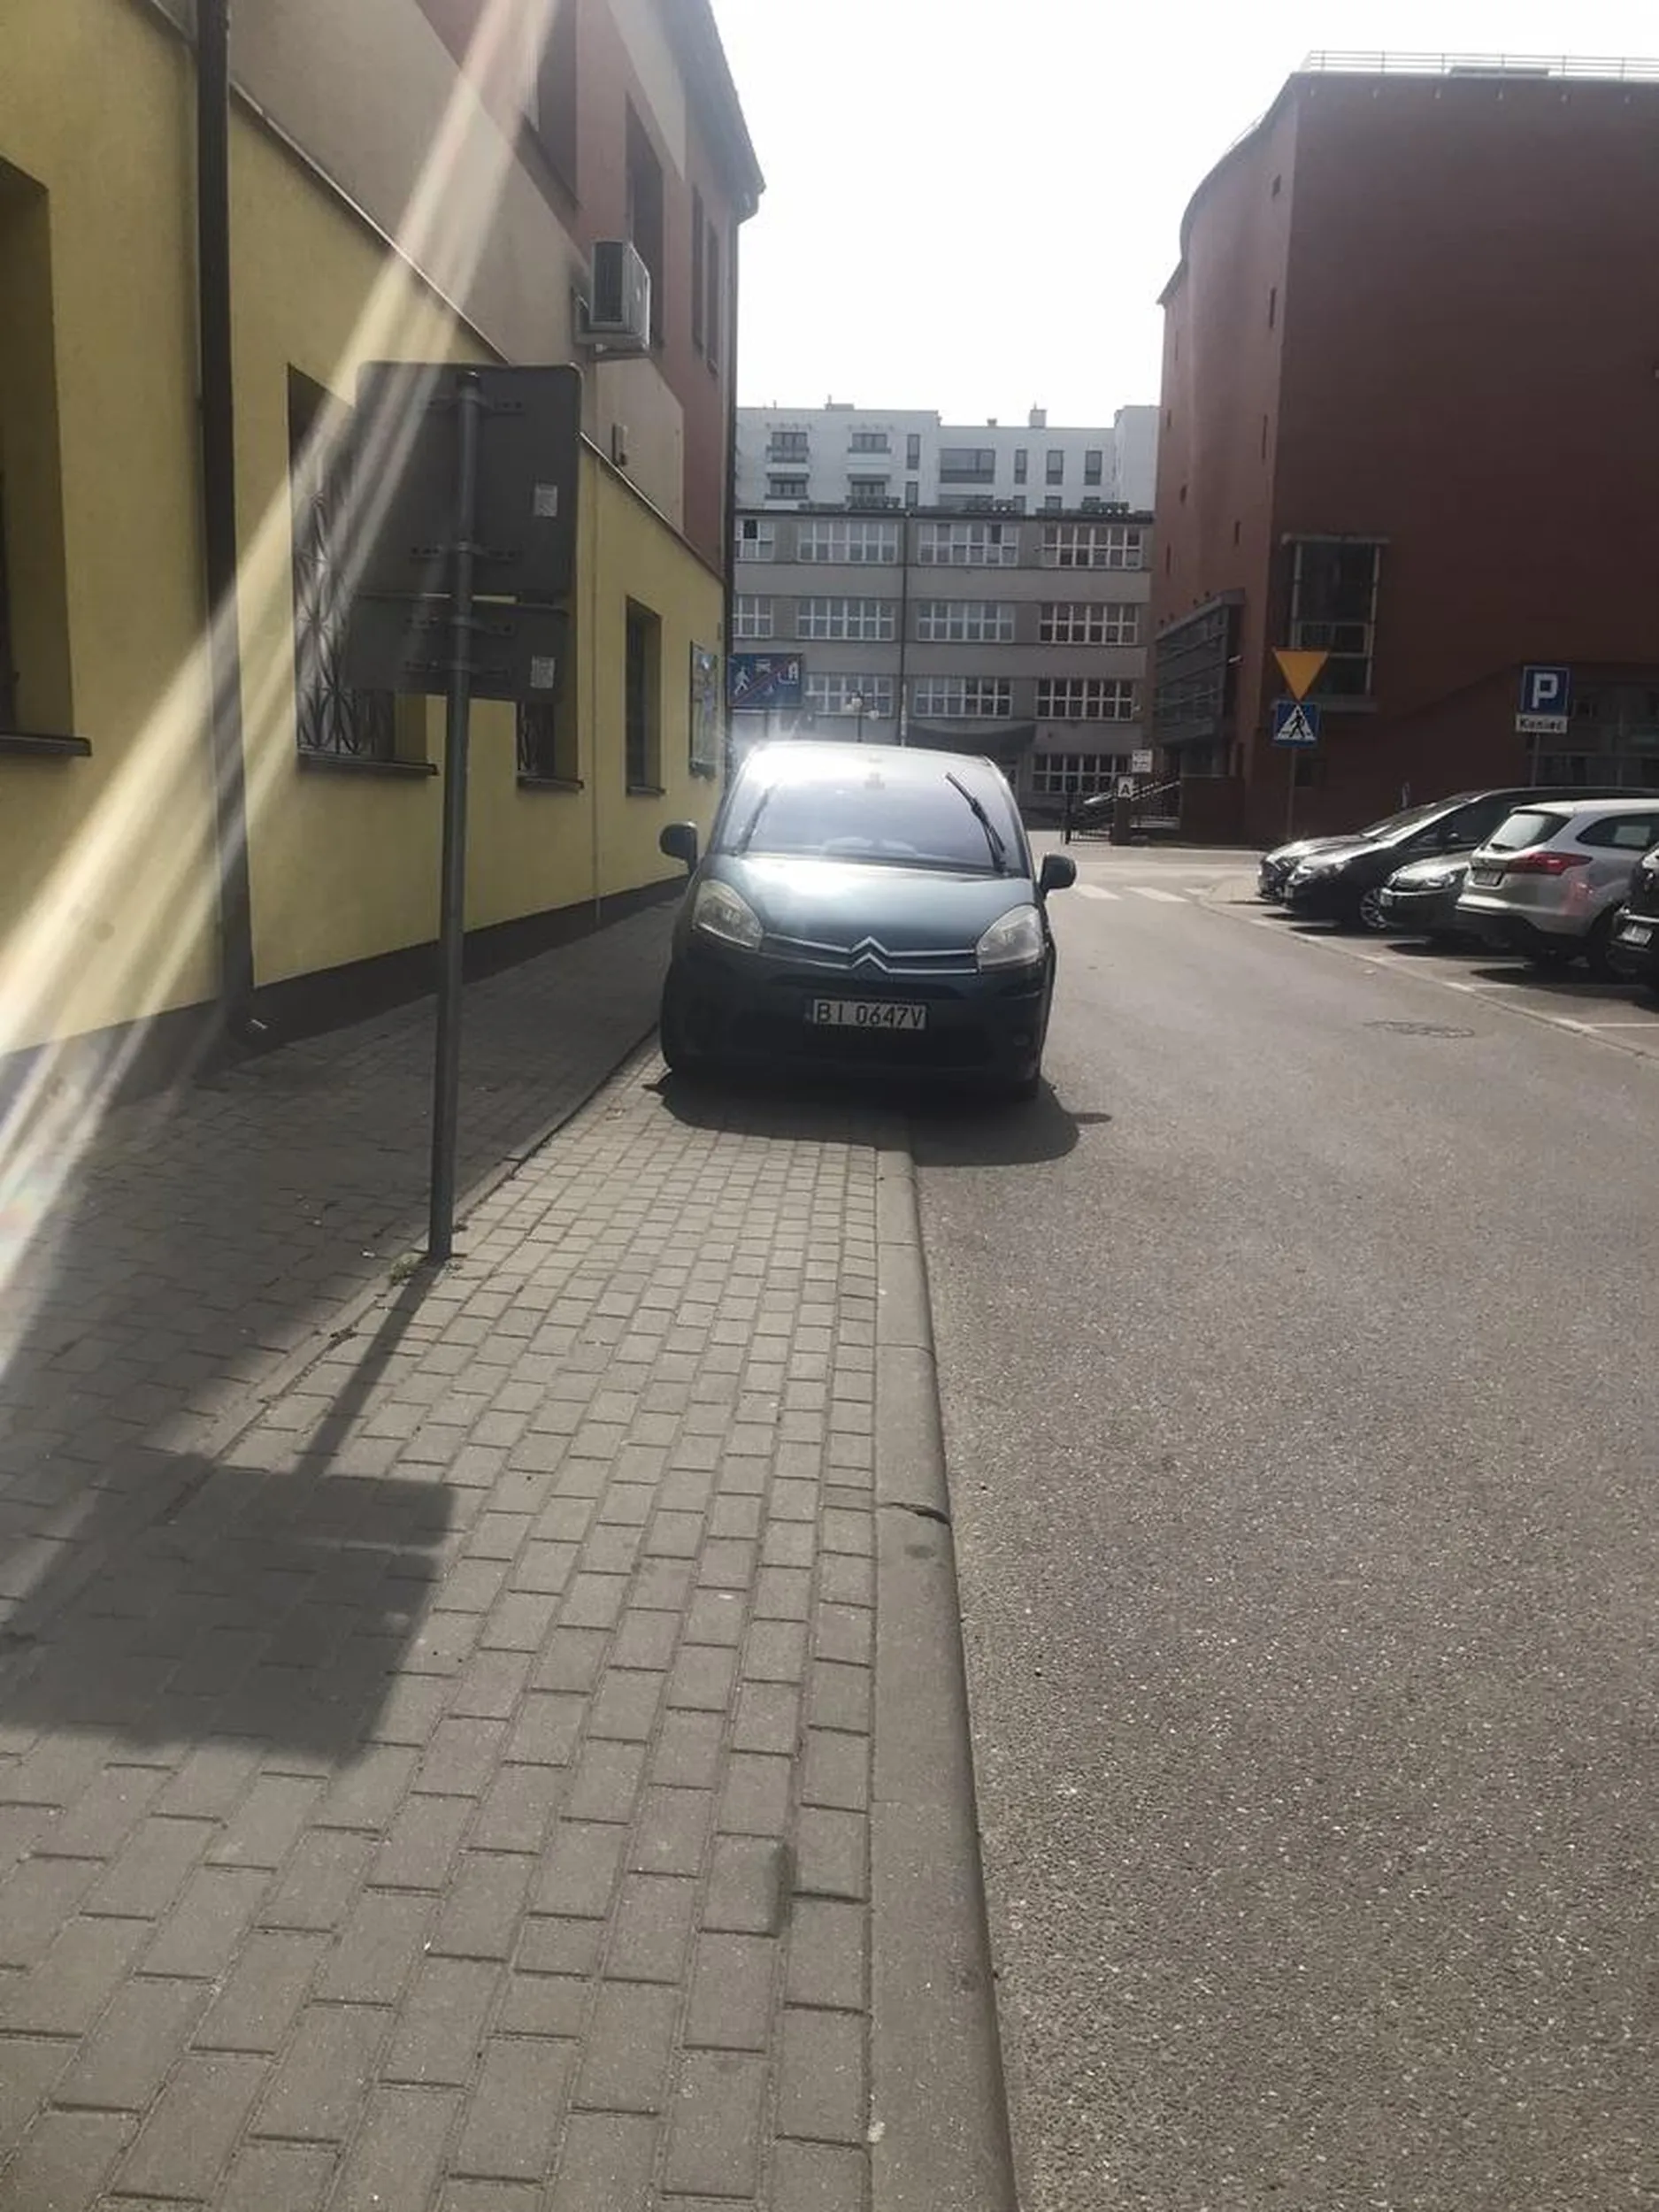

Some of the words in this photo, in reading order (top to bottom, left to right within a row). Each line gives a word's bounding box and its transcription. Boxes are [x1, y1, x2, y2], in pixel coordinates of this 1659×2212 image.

[1532, 672, 1558, 709] P
[817, 1002, 843, 1024] BI
[855, 1003, 923, 1027] 0647V
